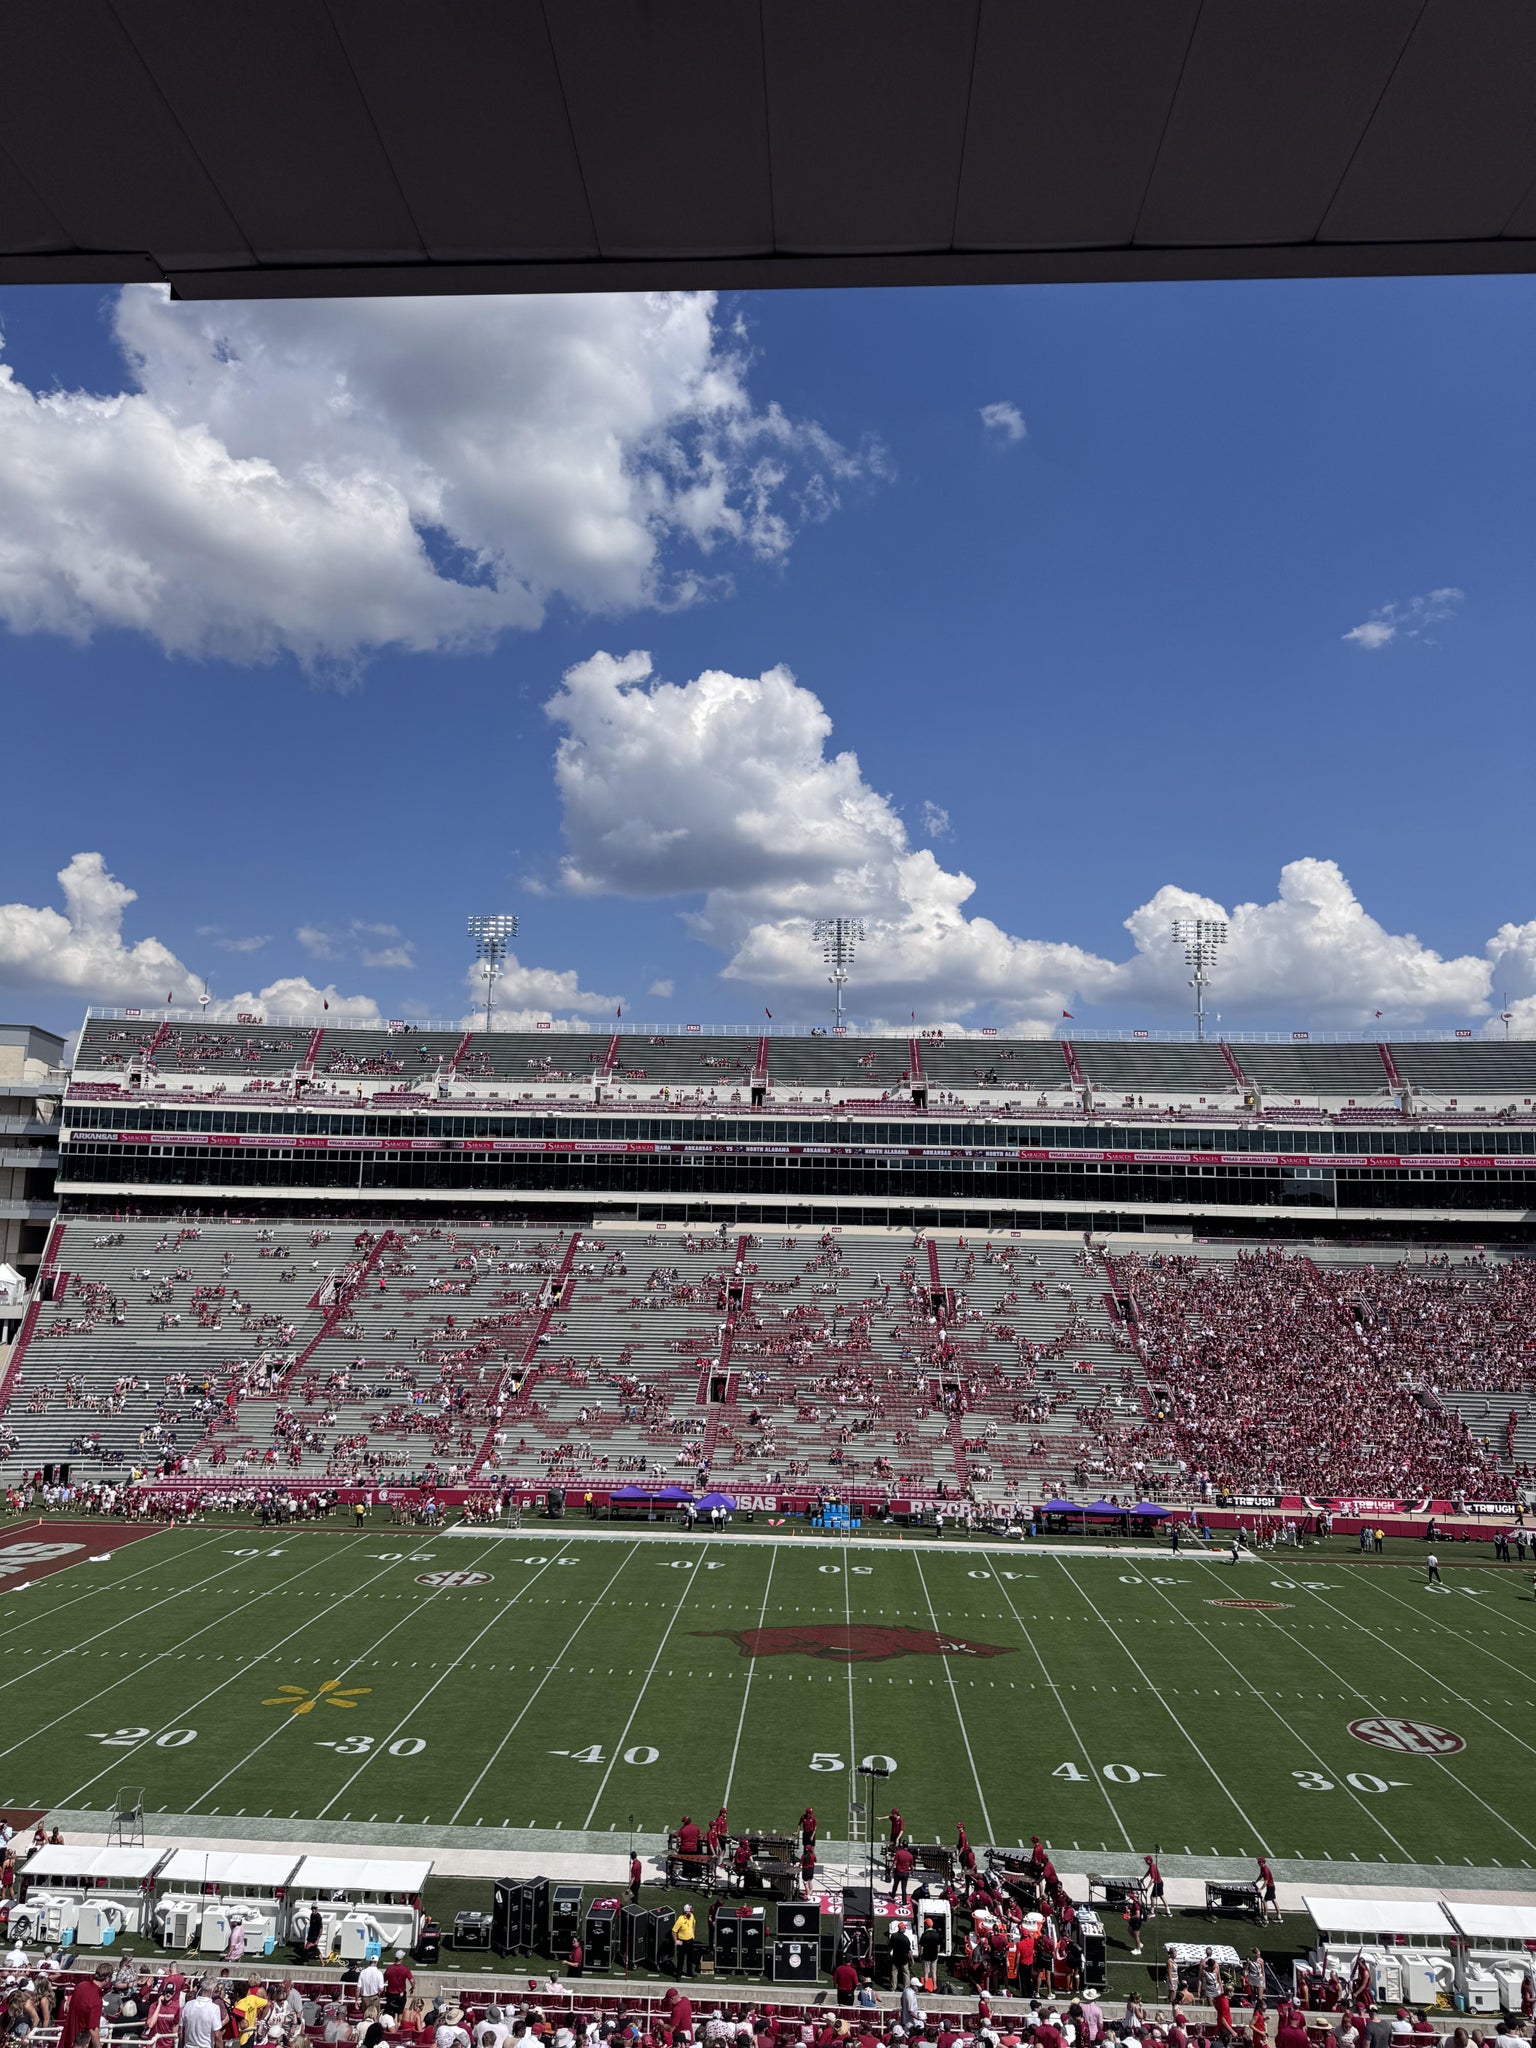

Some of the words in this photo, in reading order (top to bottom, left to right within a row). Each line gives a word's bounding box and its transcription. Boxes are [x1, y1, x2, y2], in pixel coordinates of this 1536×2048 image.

[72, 1133, 119, 1141] ARKANSAS
[421, 1571, 488, 1585] SEC
[99, 1727, 198, 1748] 20
[335, 1735, 427, 1757] 30
[1356, 1720, 1457, 1752] SEC
[570, 1744, 660, 1766] 40
[808, 1752, 898, 1774] 50
[1052, 1761, 1141, 1784] 40
[1291, 1770, 1389, 1794] 30
